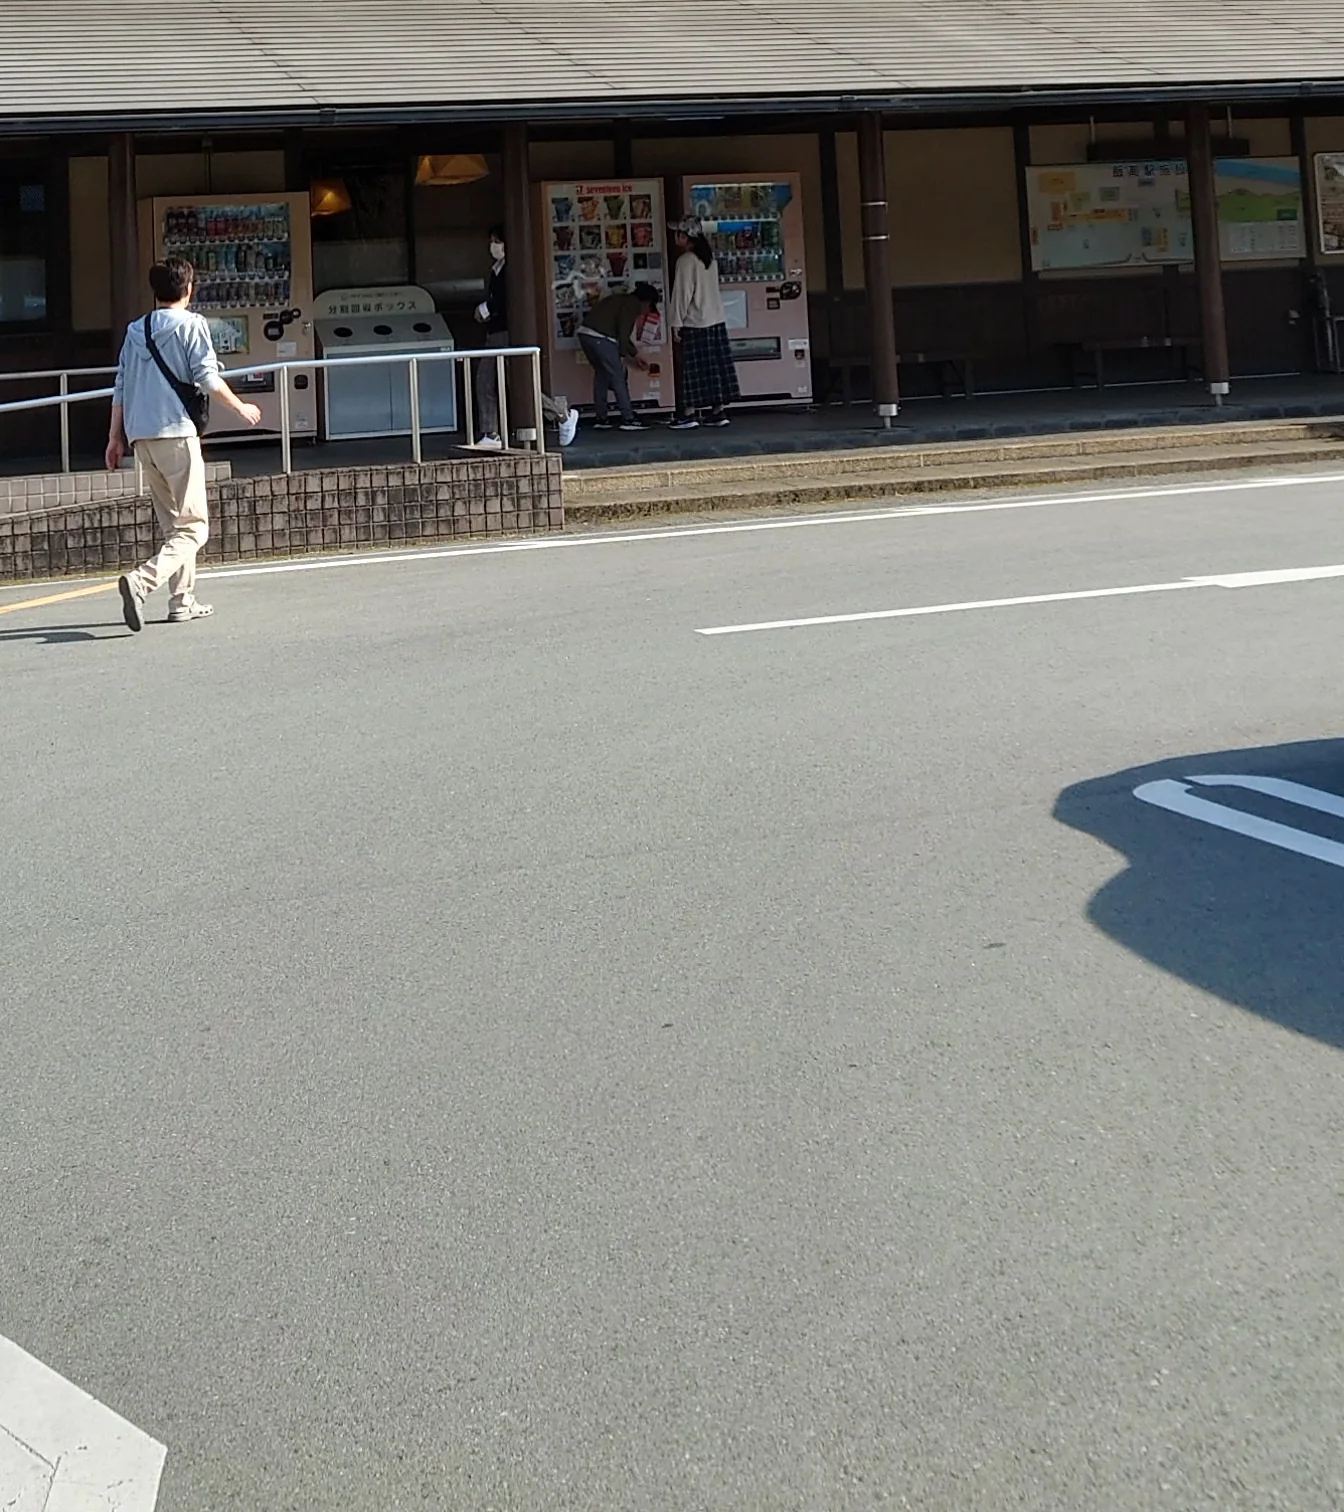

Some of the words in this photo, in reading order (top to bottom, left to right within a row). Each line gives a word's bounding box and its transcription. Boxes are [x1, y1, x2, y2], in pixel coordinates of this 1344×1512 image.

[328, 301, 417, 315] 分別回収ボックス
